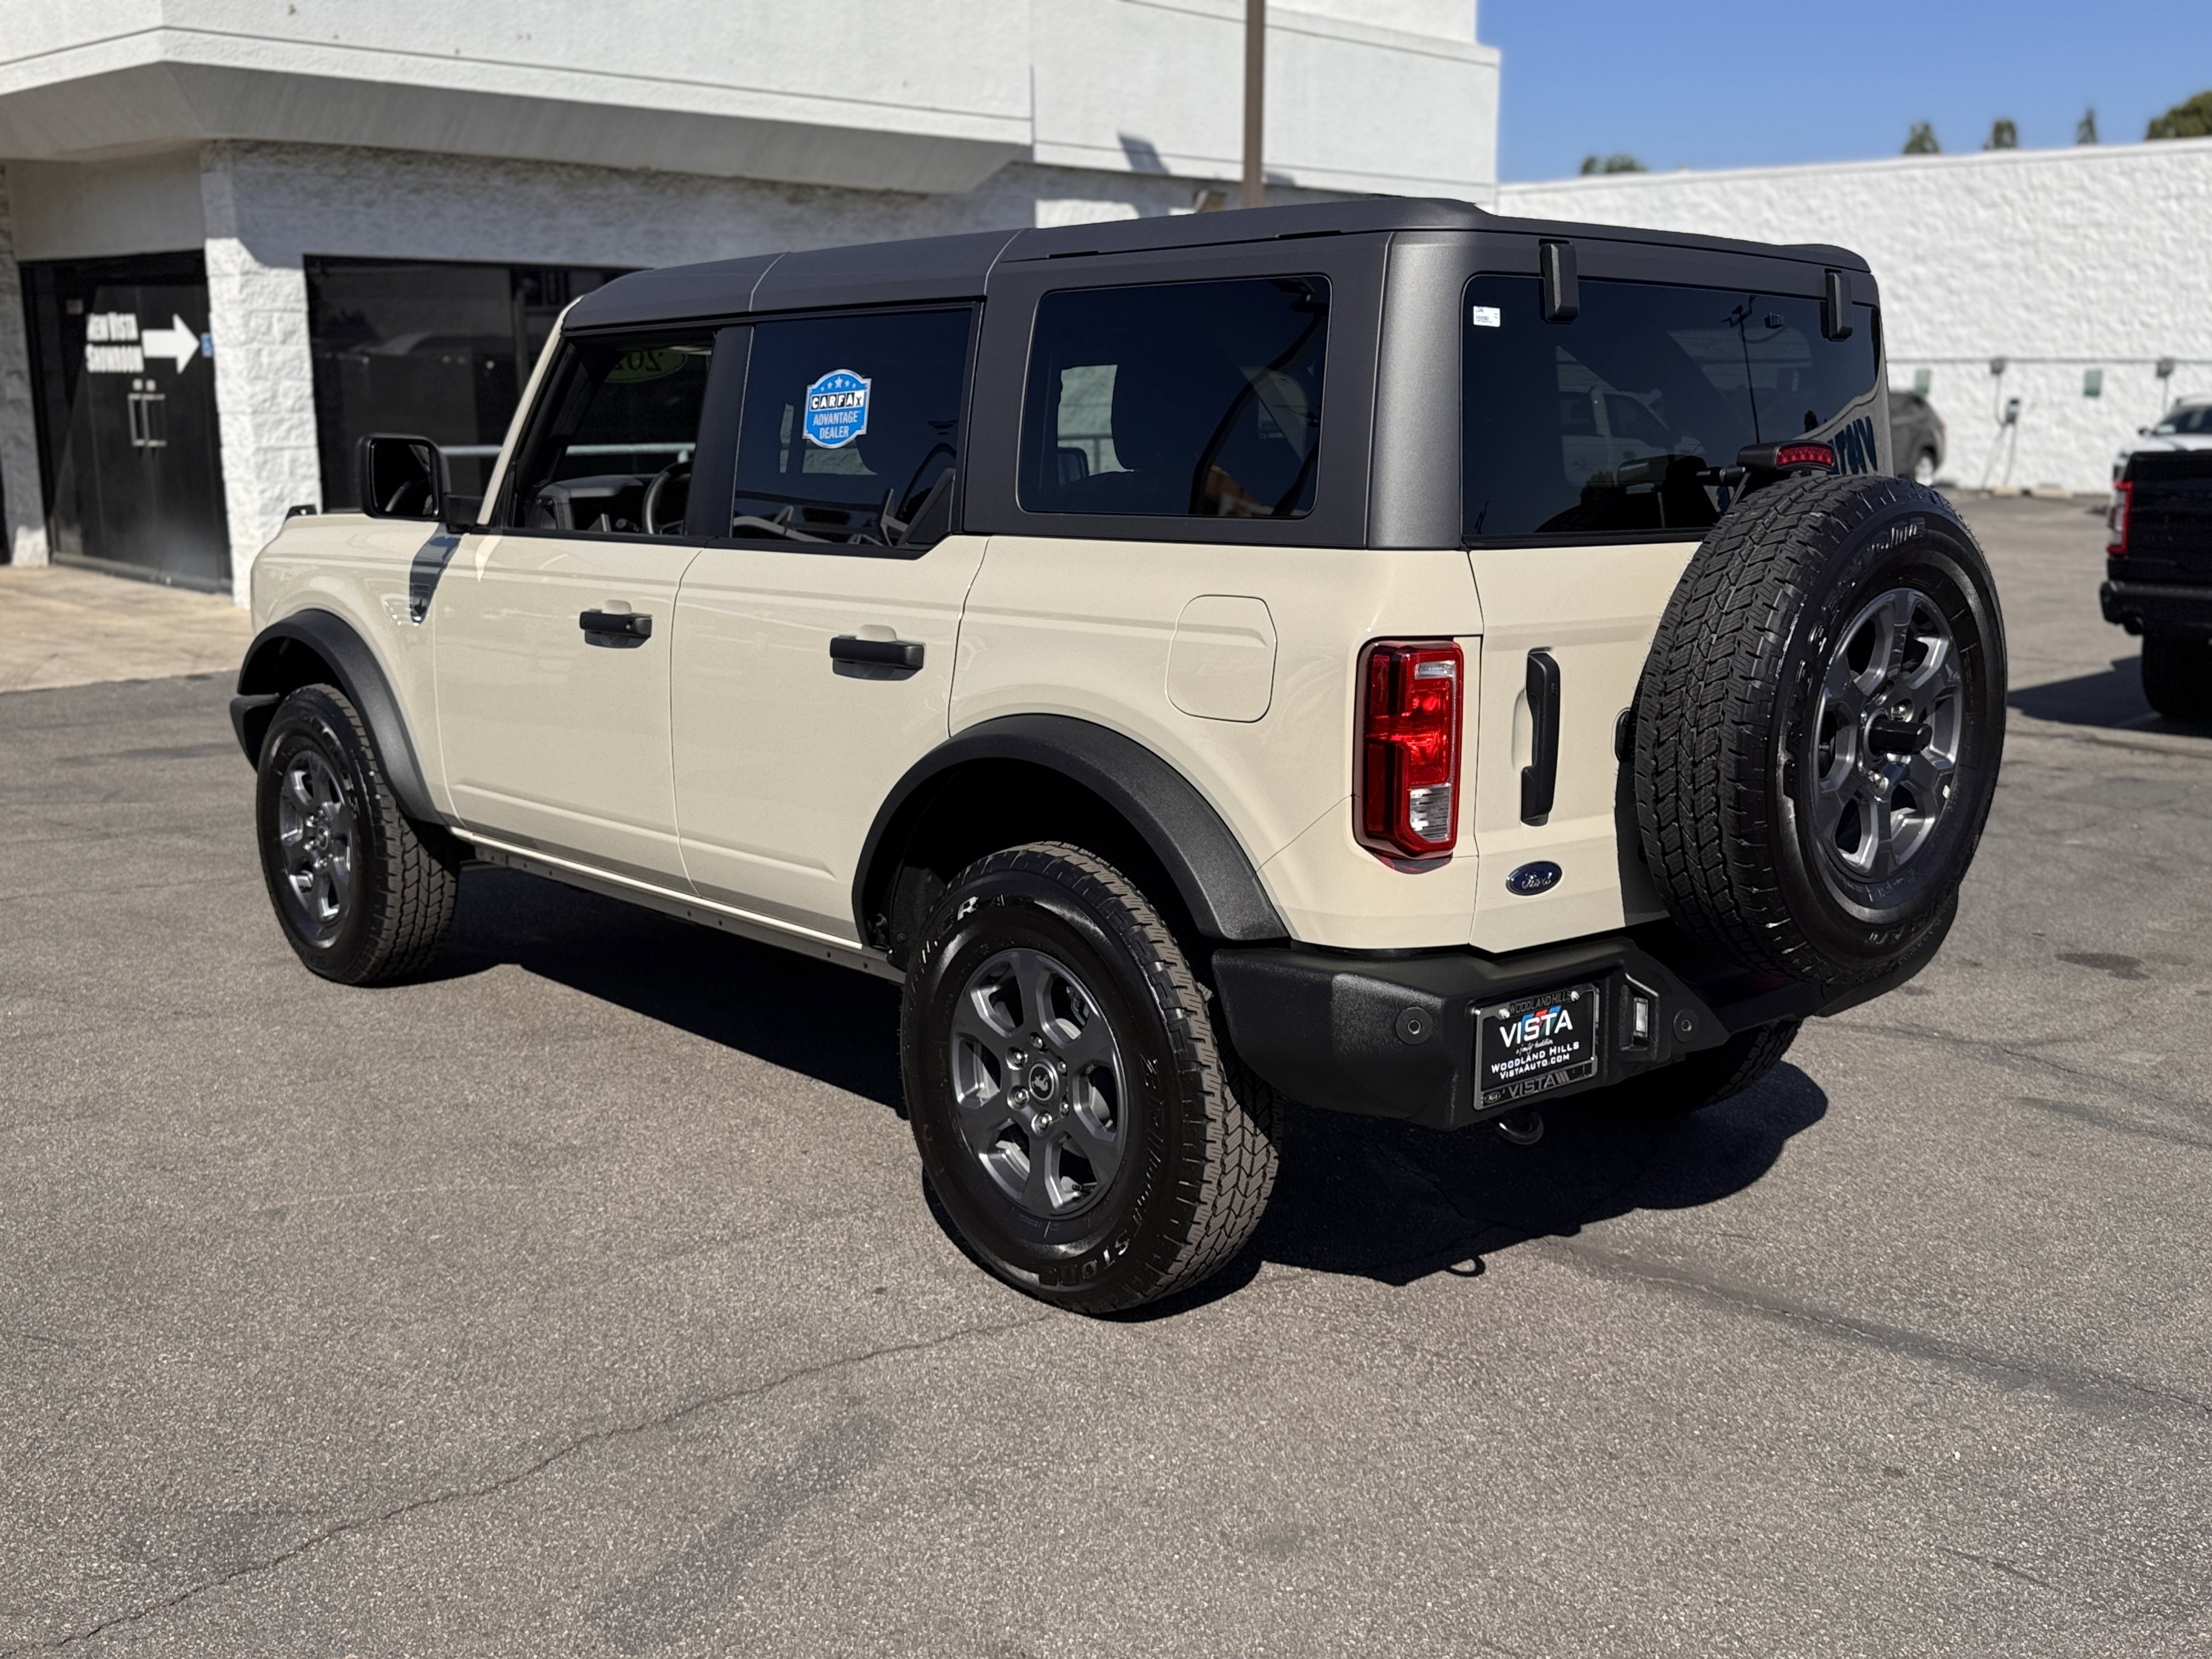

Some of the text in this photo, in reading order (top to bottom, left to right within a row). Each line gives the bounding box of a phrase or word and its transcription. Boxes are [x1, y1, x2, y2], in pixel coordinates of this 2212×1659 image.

[811, 391, 862, 409] CARFAX
[812, 411, 859, 426] ADVANTAGE
[819, 426, 849, 439] DEALER
[1510, 996, 1551, 1014] WOODLAND
[1499, 1009, 1573, 1048] VISTA
[1491, 1041, 1579, 1074] WOODLAND HILLS
[1508, 1073, 1557, 1098] VISTA
